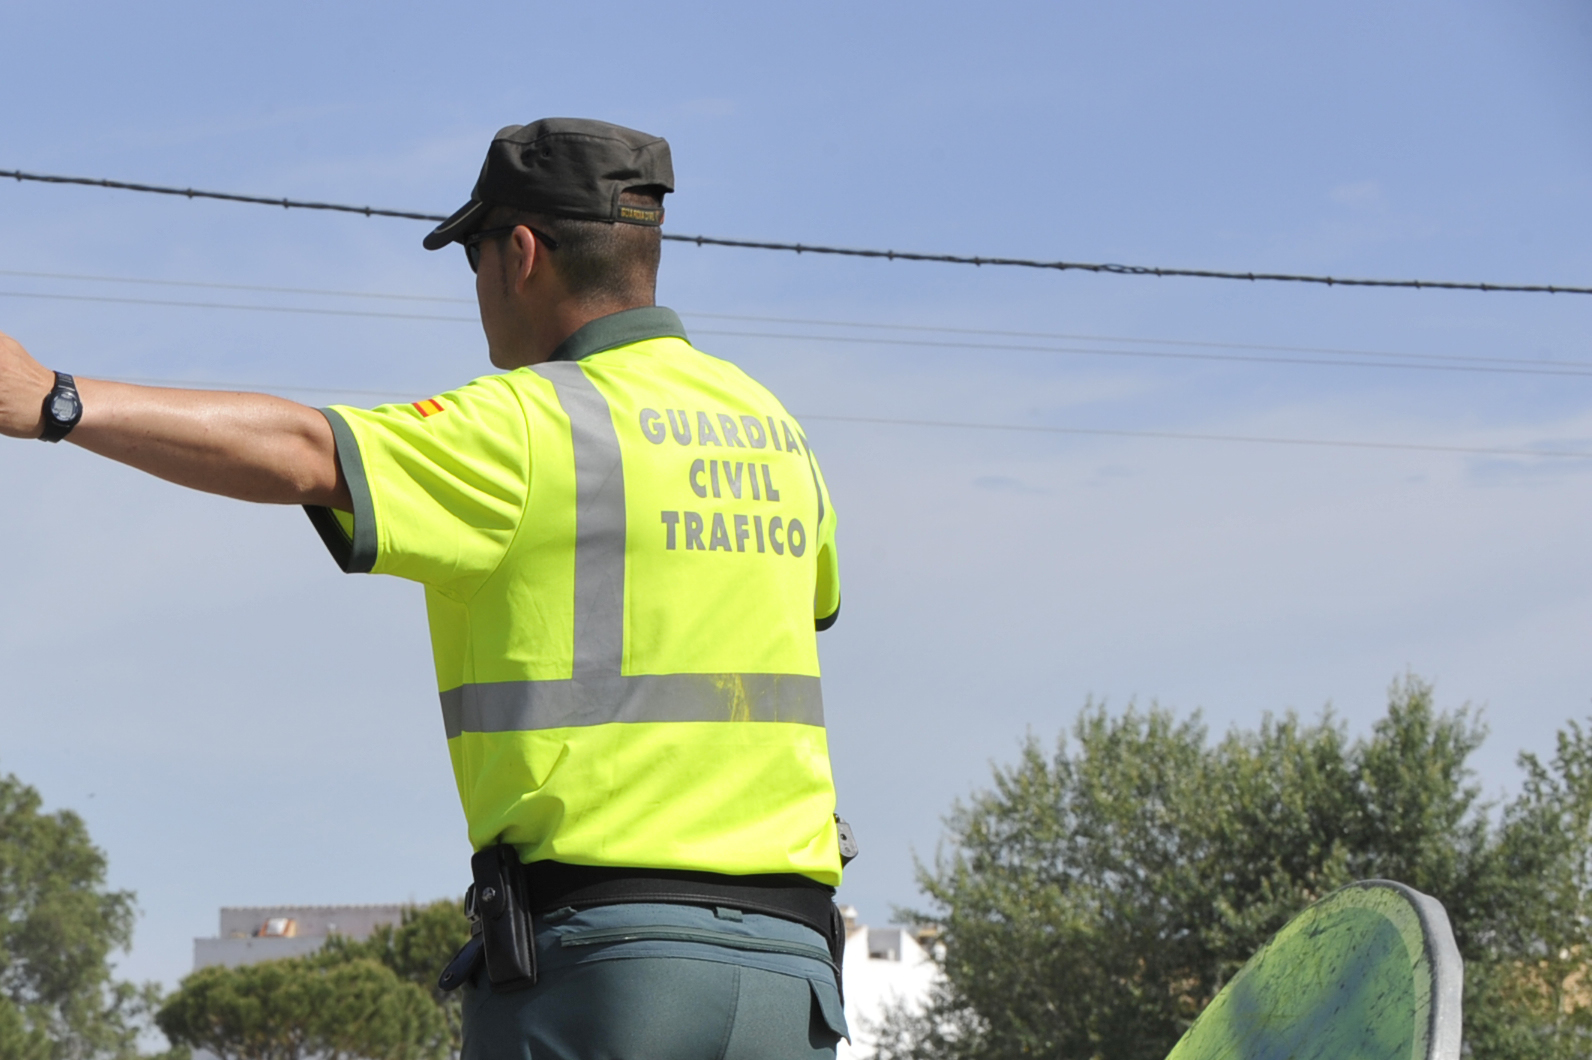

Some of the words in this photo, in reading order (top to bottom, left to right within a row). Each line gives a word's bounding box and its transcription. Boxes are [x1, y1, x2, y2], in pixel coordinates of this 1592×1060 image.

[639, 407, 803, 457] GUARDIA
[689, 458, 781, 503] CIVIL
[661, 510, 806, 558] TRAFICO
